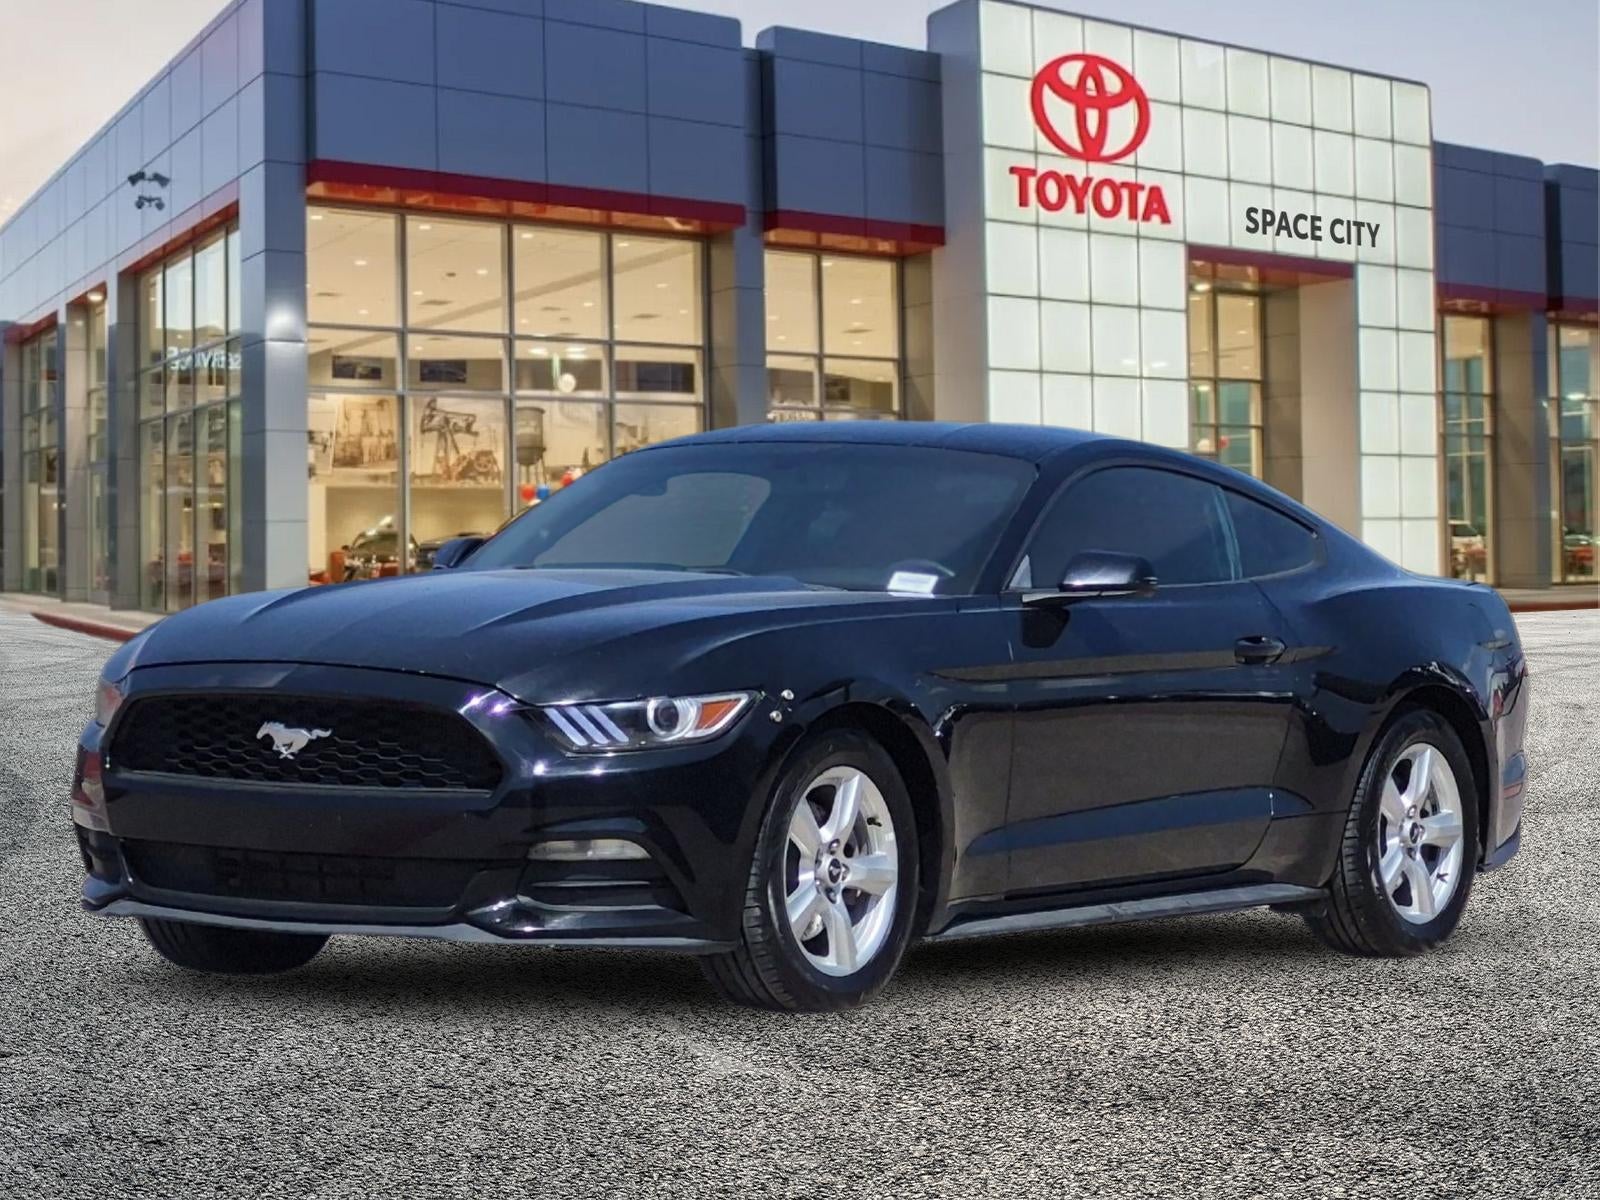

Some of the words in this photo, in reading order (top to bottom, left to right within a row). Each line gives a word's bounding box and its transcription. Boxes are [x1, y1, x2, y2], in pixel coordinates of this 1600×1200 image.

[1009, 166, 1171, 224] TOYOTA
[1245, 206, 1323, 242] SPACE
[1329, 218, 1381, 248] CITY
